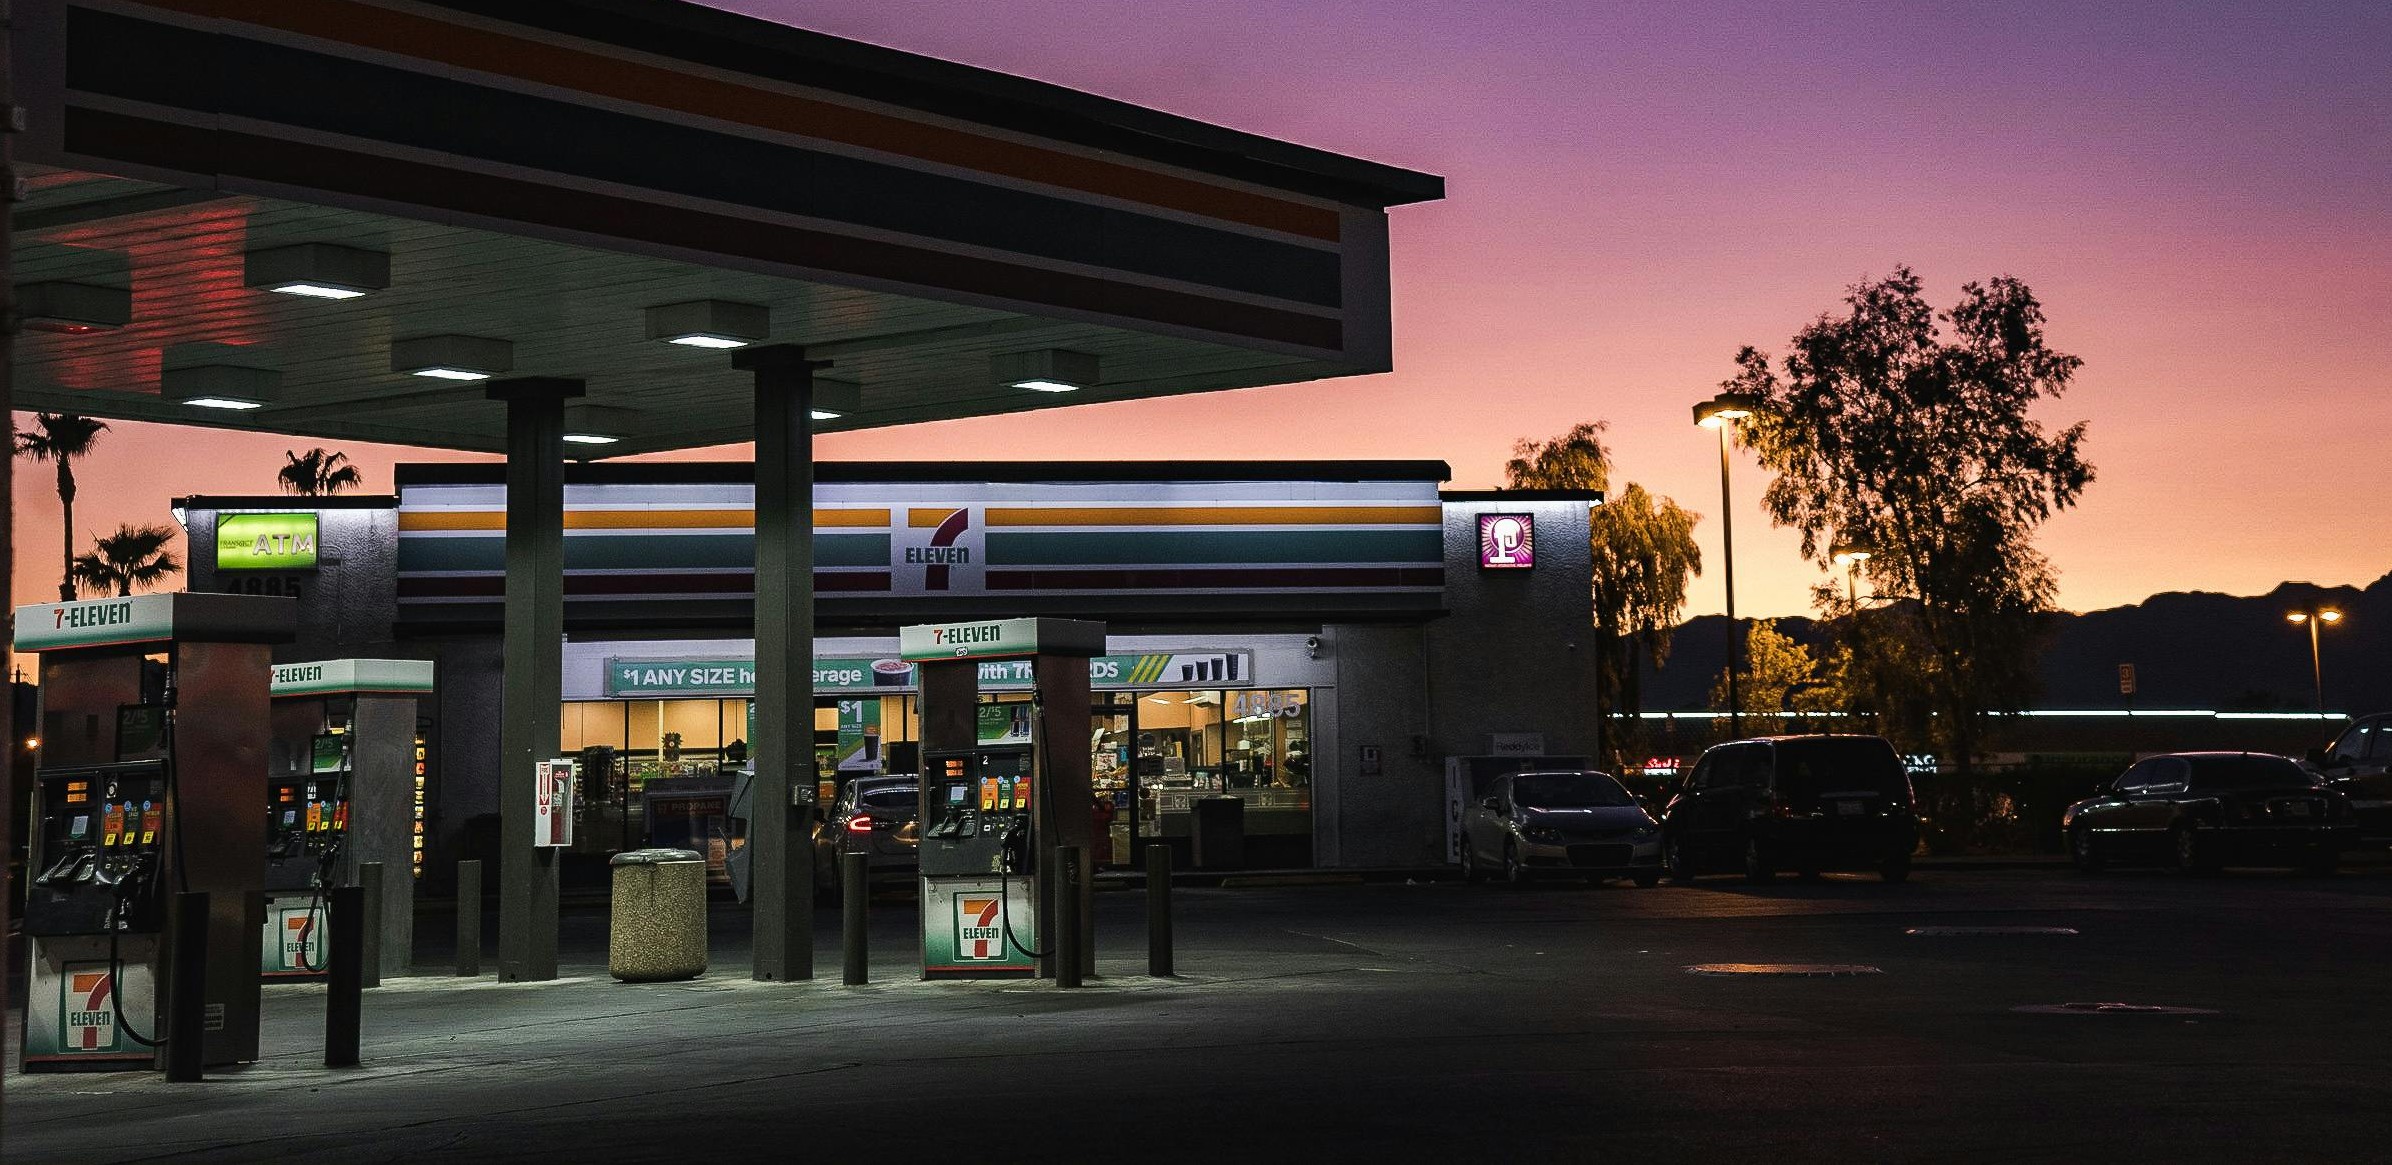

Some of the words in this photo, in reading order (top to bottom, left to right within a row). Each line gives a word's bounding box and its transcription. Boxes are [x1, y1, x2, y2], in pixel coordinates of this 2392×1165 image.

[253, 533, 315, 555] ATM
[623, 668, 639, 686] $1
[643, 668, 687, 686] ANY
[690, 667, 735, 685] SIZE
[840, 700, 863, 723] $1
[1233, 693, 1301, 718] 4885
[982, 755, 989, 765] 2
[671, 801, 722, 811] PROPANE
